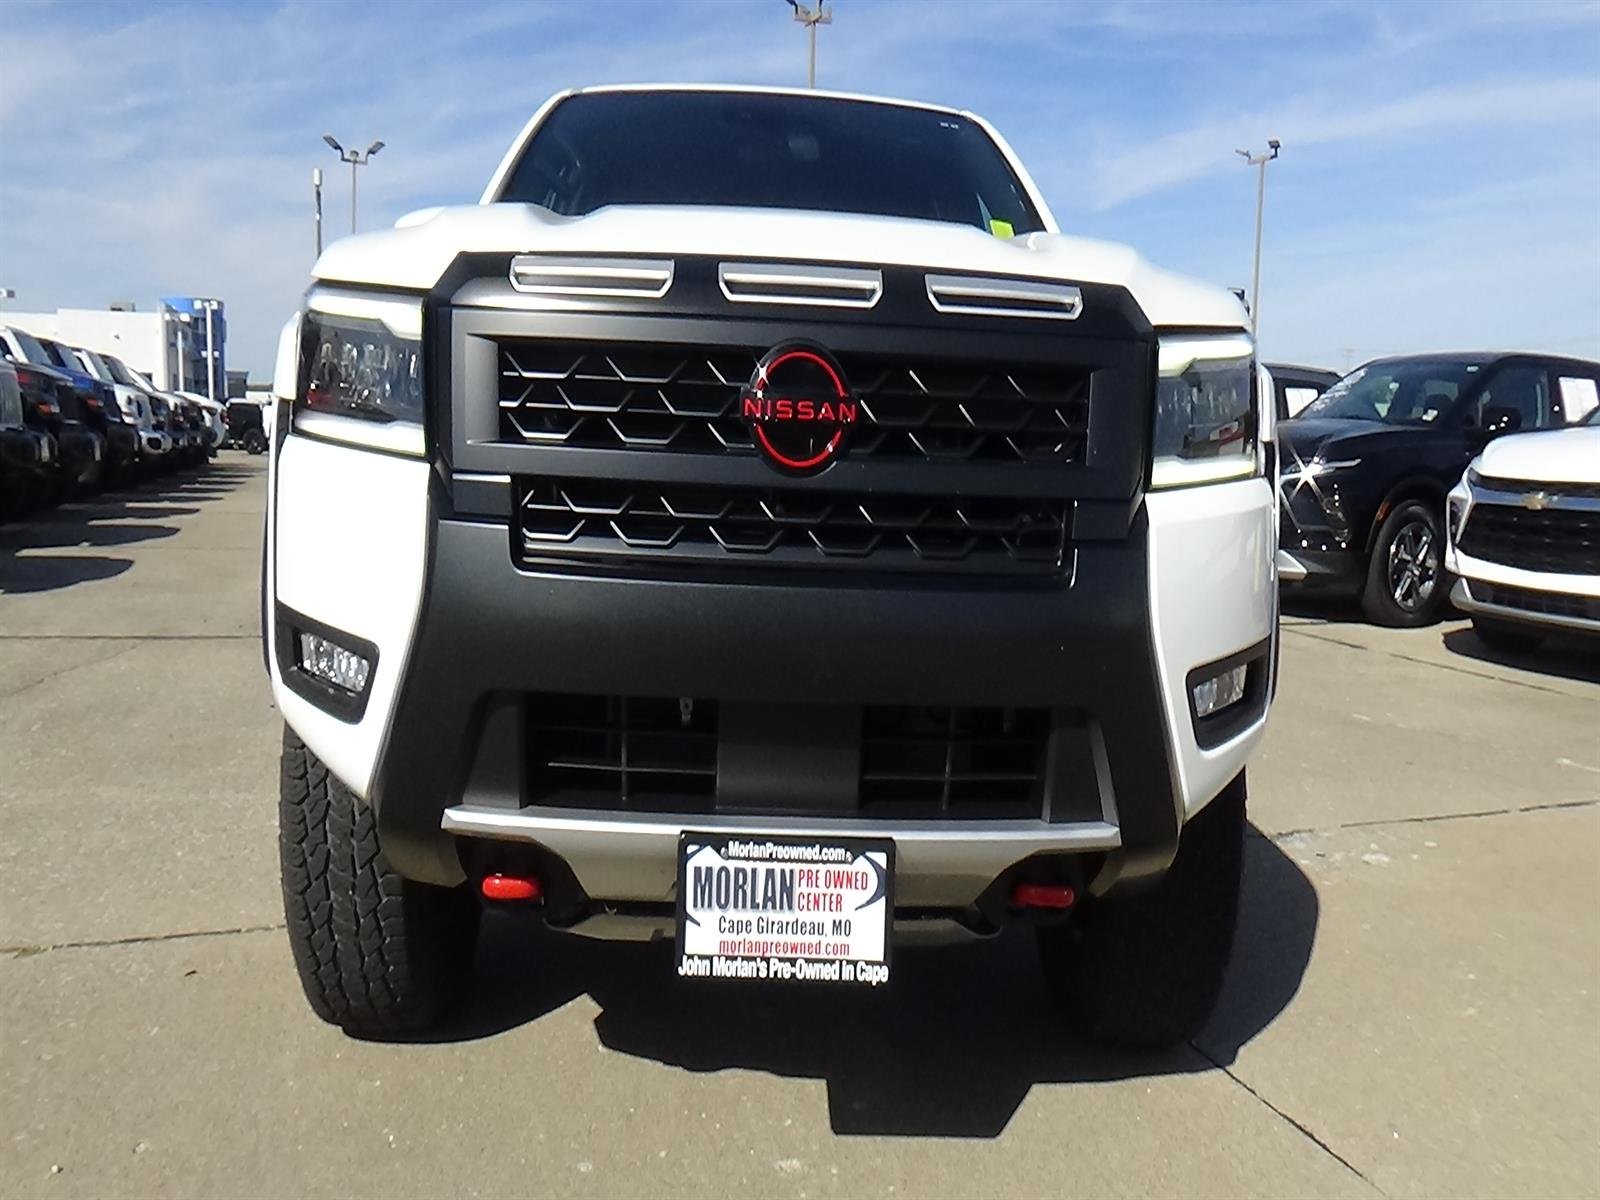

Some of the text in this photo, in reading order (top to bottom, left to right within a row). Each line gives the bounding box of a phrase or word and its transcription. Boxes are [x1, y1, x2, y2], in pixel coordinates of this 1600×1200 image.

[743, 398, 857, 423] NISSAN
[728, 841, 845, 861] MorlanPreowned.com
[693, 866, 795, 911] MORLAN
[798, 868, 868, 891] PRE OWNED
[798, 892, 843, 912] CENTER
[718, 916, 851, 937] Cape Girardeau, MO
[719, 938, 850, 957] morlanpreowned.com
[678, 956, 889, 986] John Morlan's Pre-Owned in Cape
